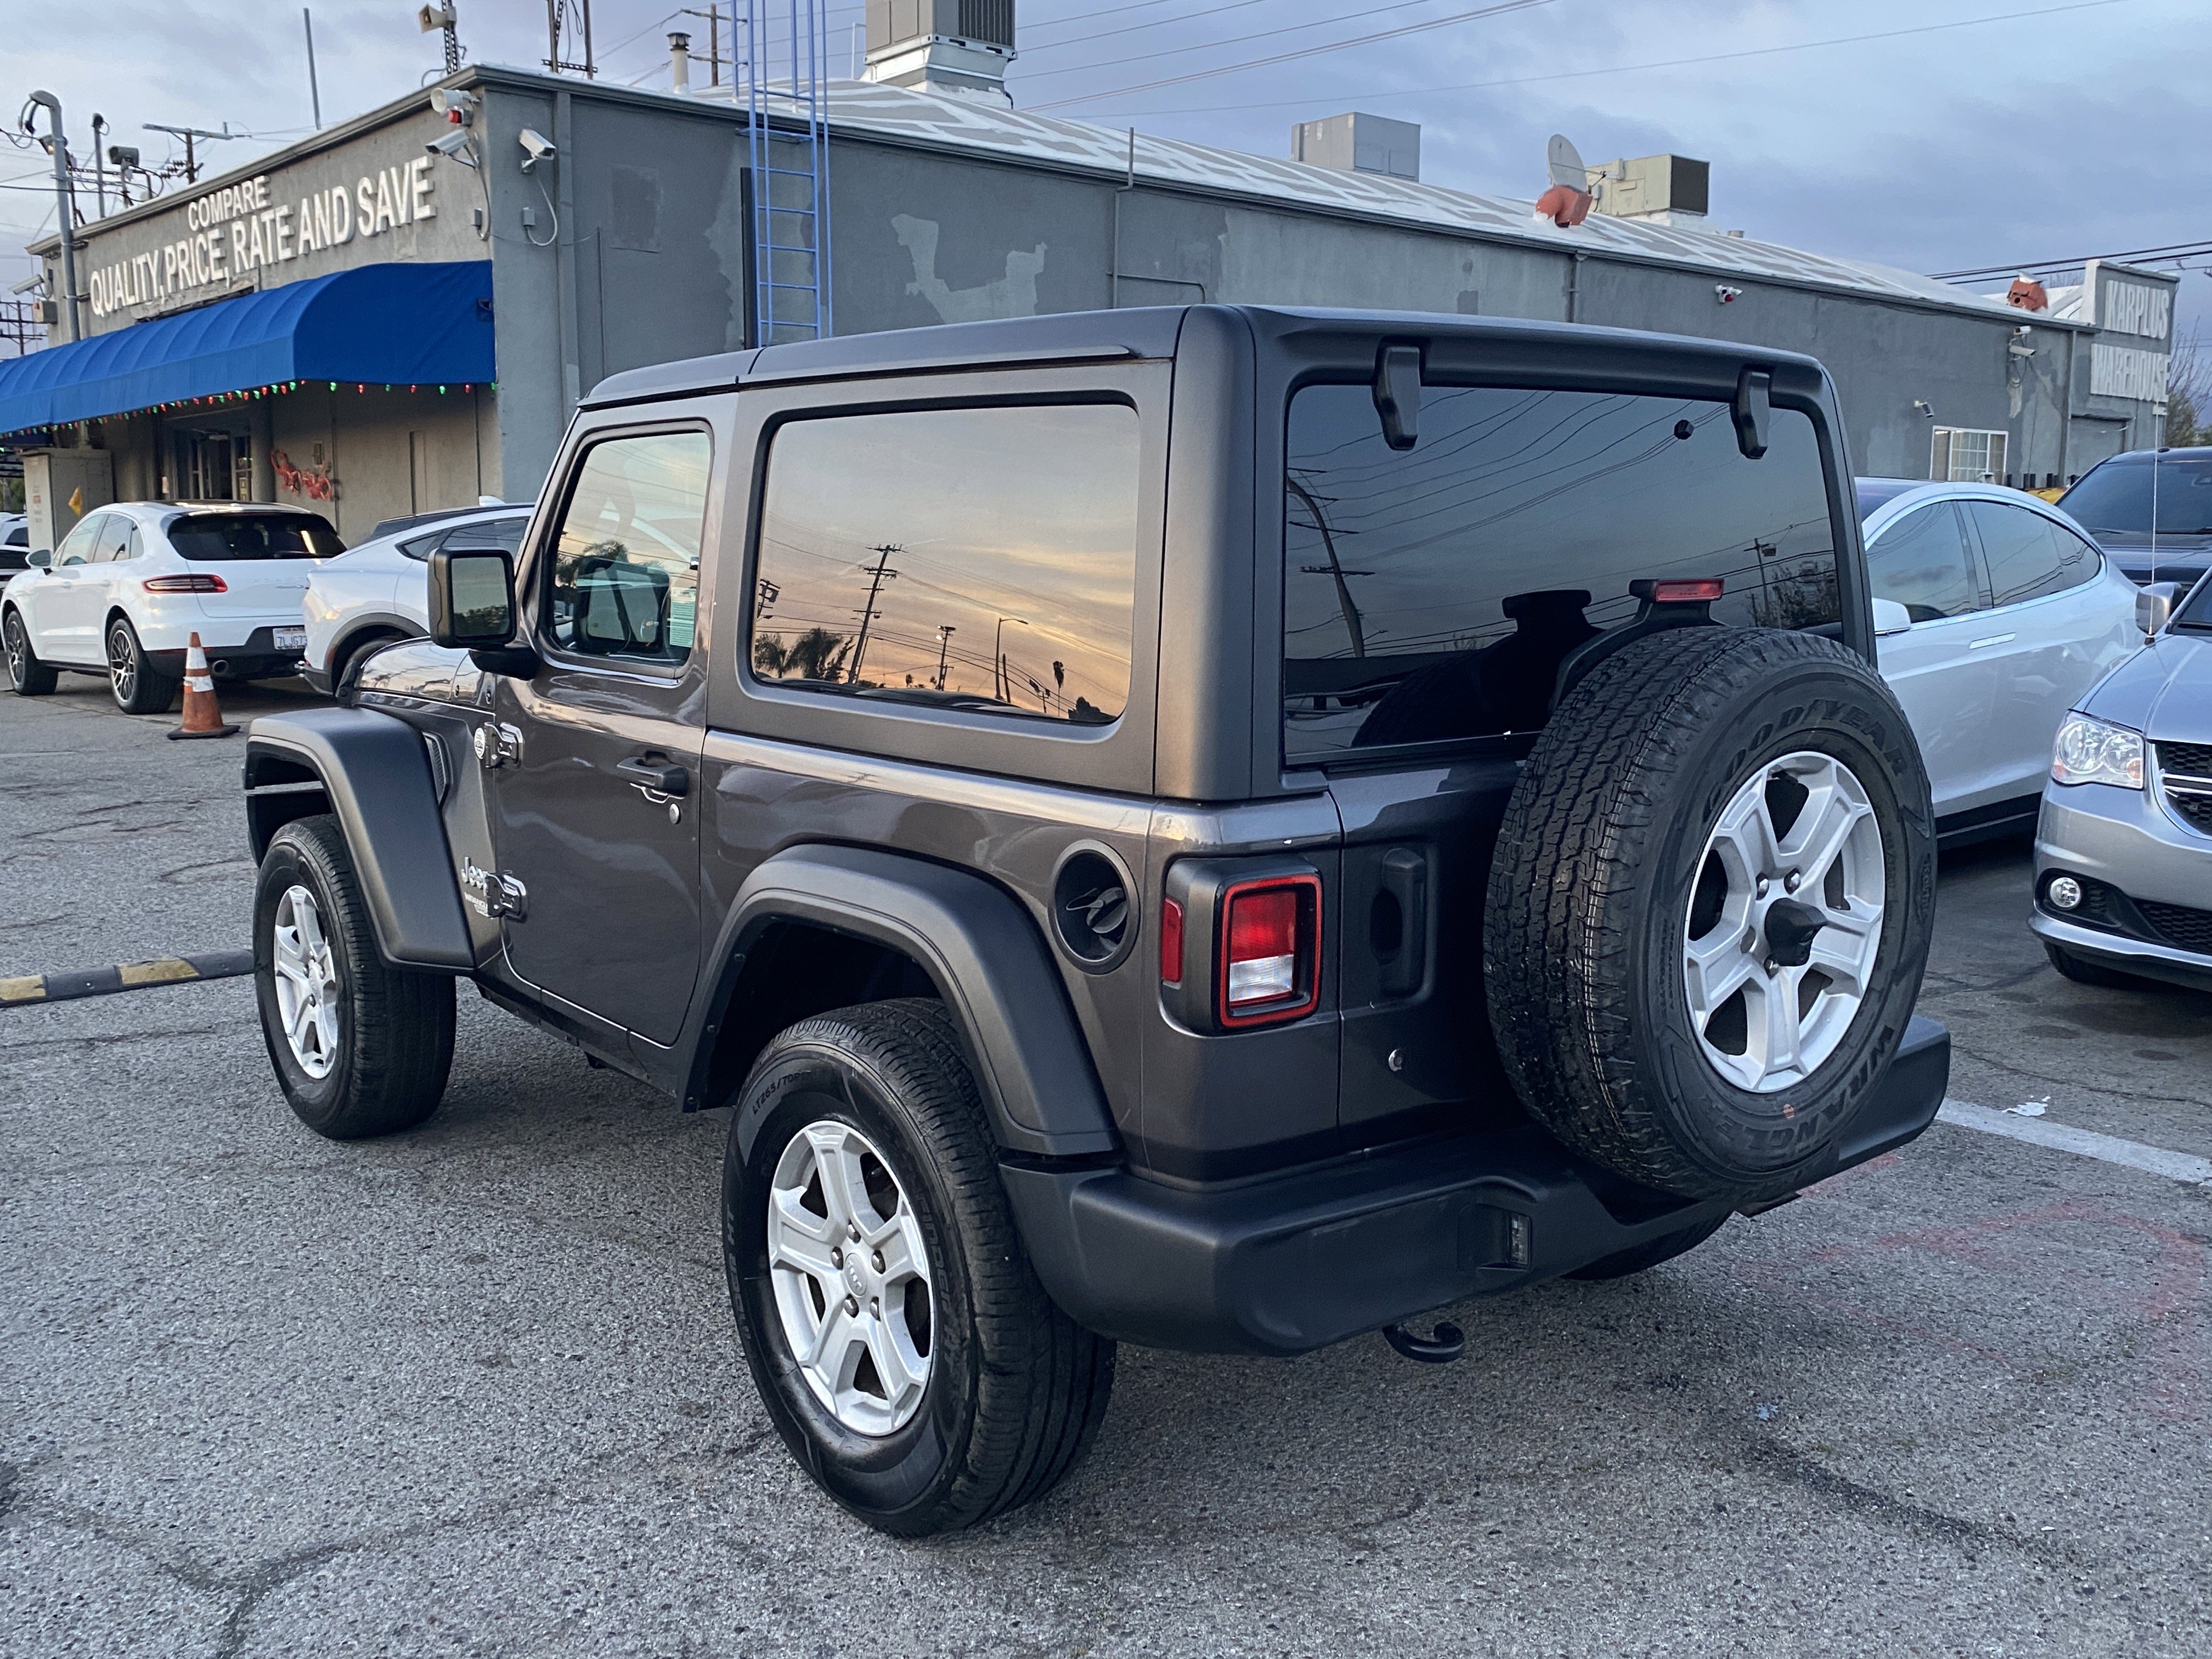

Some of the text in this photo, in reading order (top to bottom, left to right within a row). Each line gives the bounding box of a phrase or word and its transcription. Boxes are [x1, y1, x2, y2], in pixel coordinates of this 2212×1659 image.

[188, 176, 271, 232] COMPARE
[90, 156, 437, 317] QUALITY, PRICE, RATE AND SAVE
[2105, 280, 2169, 340] KARPLUS
[277, 635, 307, 646] 7LJG73
[1704, 698, 1906, 824] GOODYEAR
[752, 1071, 811, 1114] LT265/70R
[1711, 1024, 1894, 1151] WRANGLER
